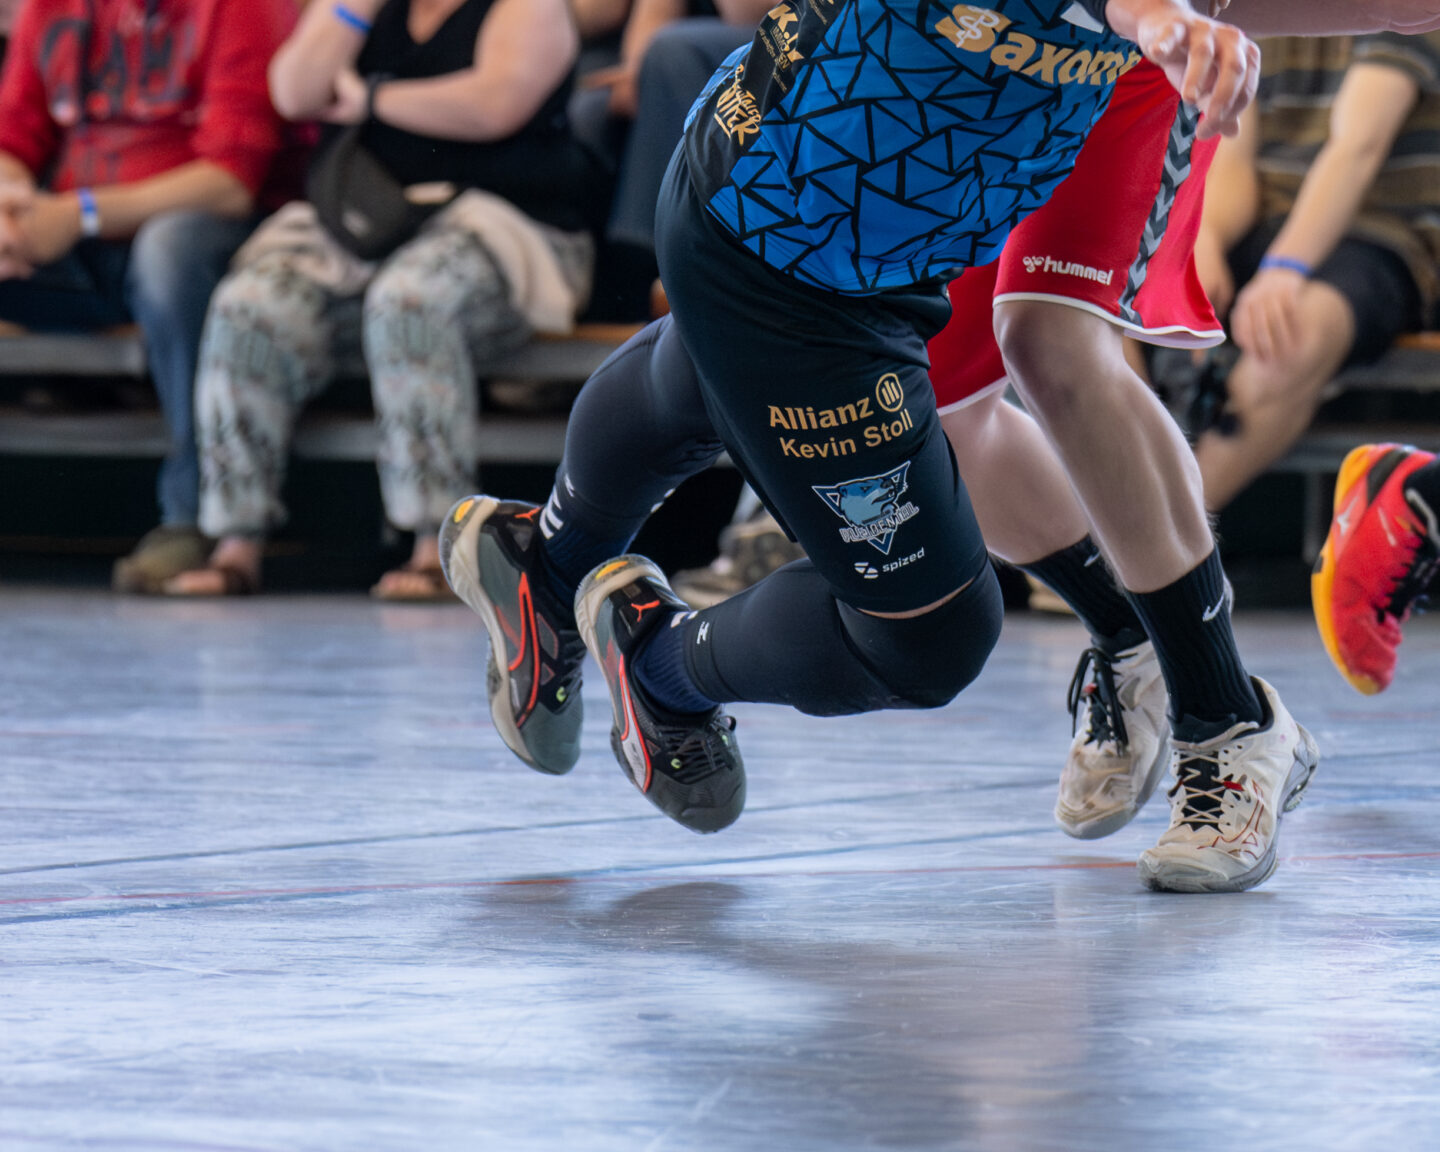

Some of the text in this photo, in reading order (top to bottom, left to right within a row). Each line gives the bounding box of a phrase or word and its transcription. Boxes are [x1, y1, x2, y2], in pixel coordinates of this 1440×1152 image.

[1043, 255, 1114, 286] hummel
[768, 397, 874, 430] Allianz
[780, 408, 914, 459] Kevin Stoll
[882, 546, 926, 574] spized
